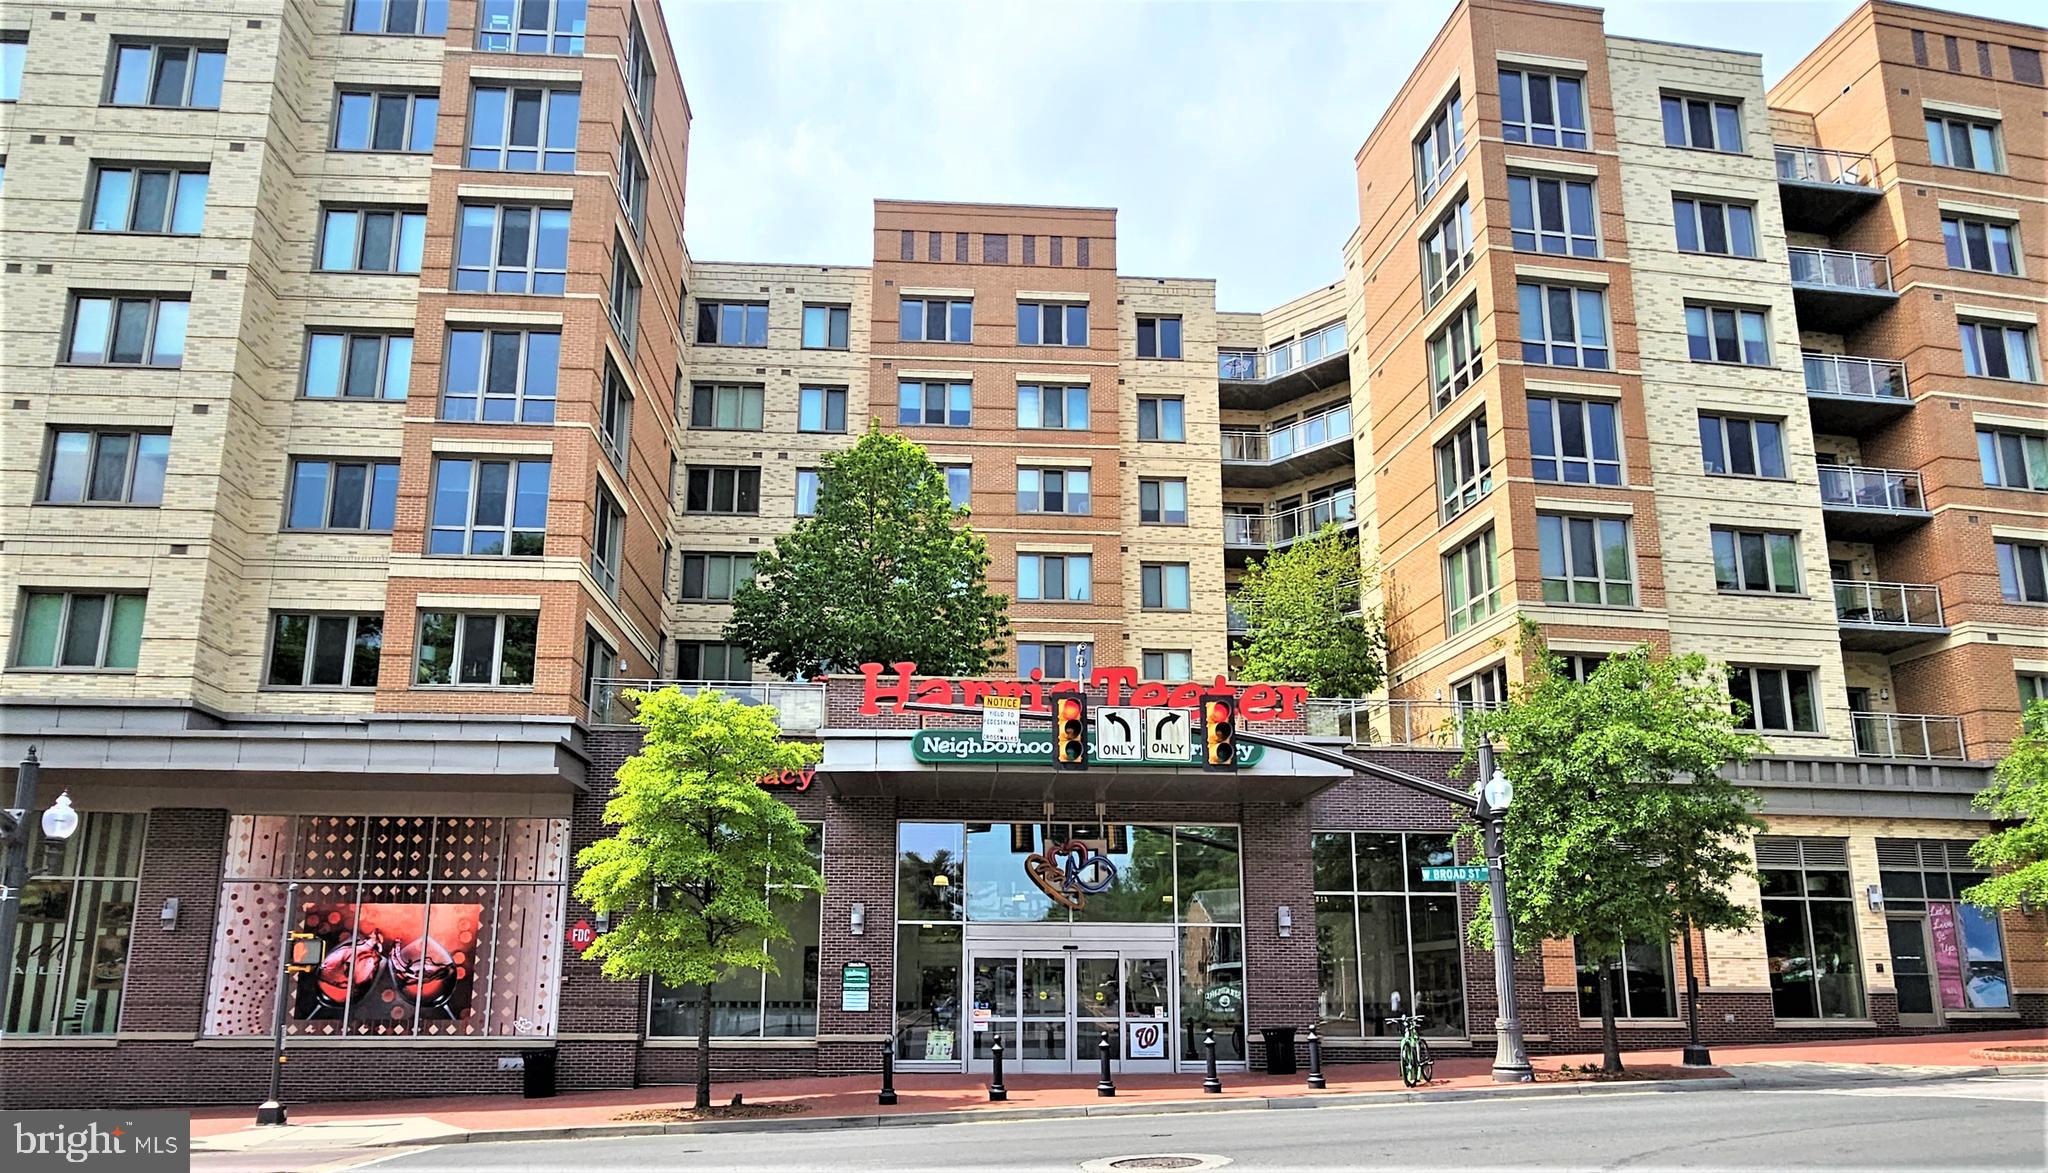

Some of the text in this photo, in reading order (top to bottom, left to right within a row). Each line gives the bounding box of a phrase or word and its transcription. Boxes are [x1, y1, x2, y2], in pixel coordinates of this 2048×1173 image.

[987, 697, 1018, 708] NOTICE
[1103, 744, 1136, 756] ONLY
[1151, 743, 1185, 755] ONLY
[1422, 869, 1430, 880] W
[1433, 869, 1466, 880] BROAD
[1468, 869, 1480, 879] ST
[572, 928, 590, 942] FDC
